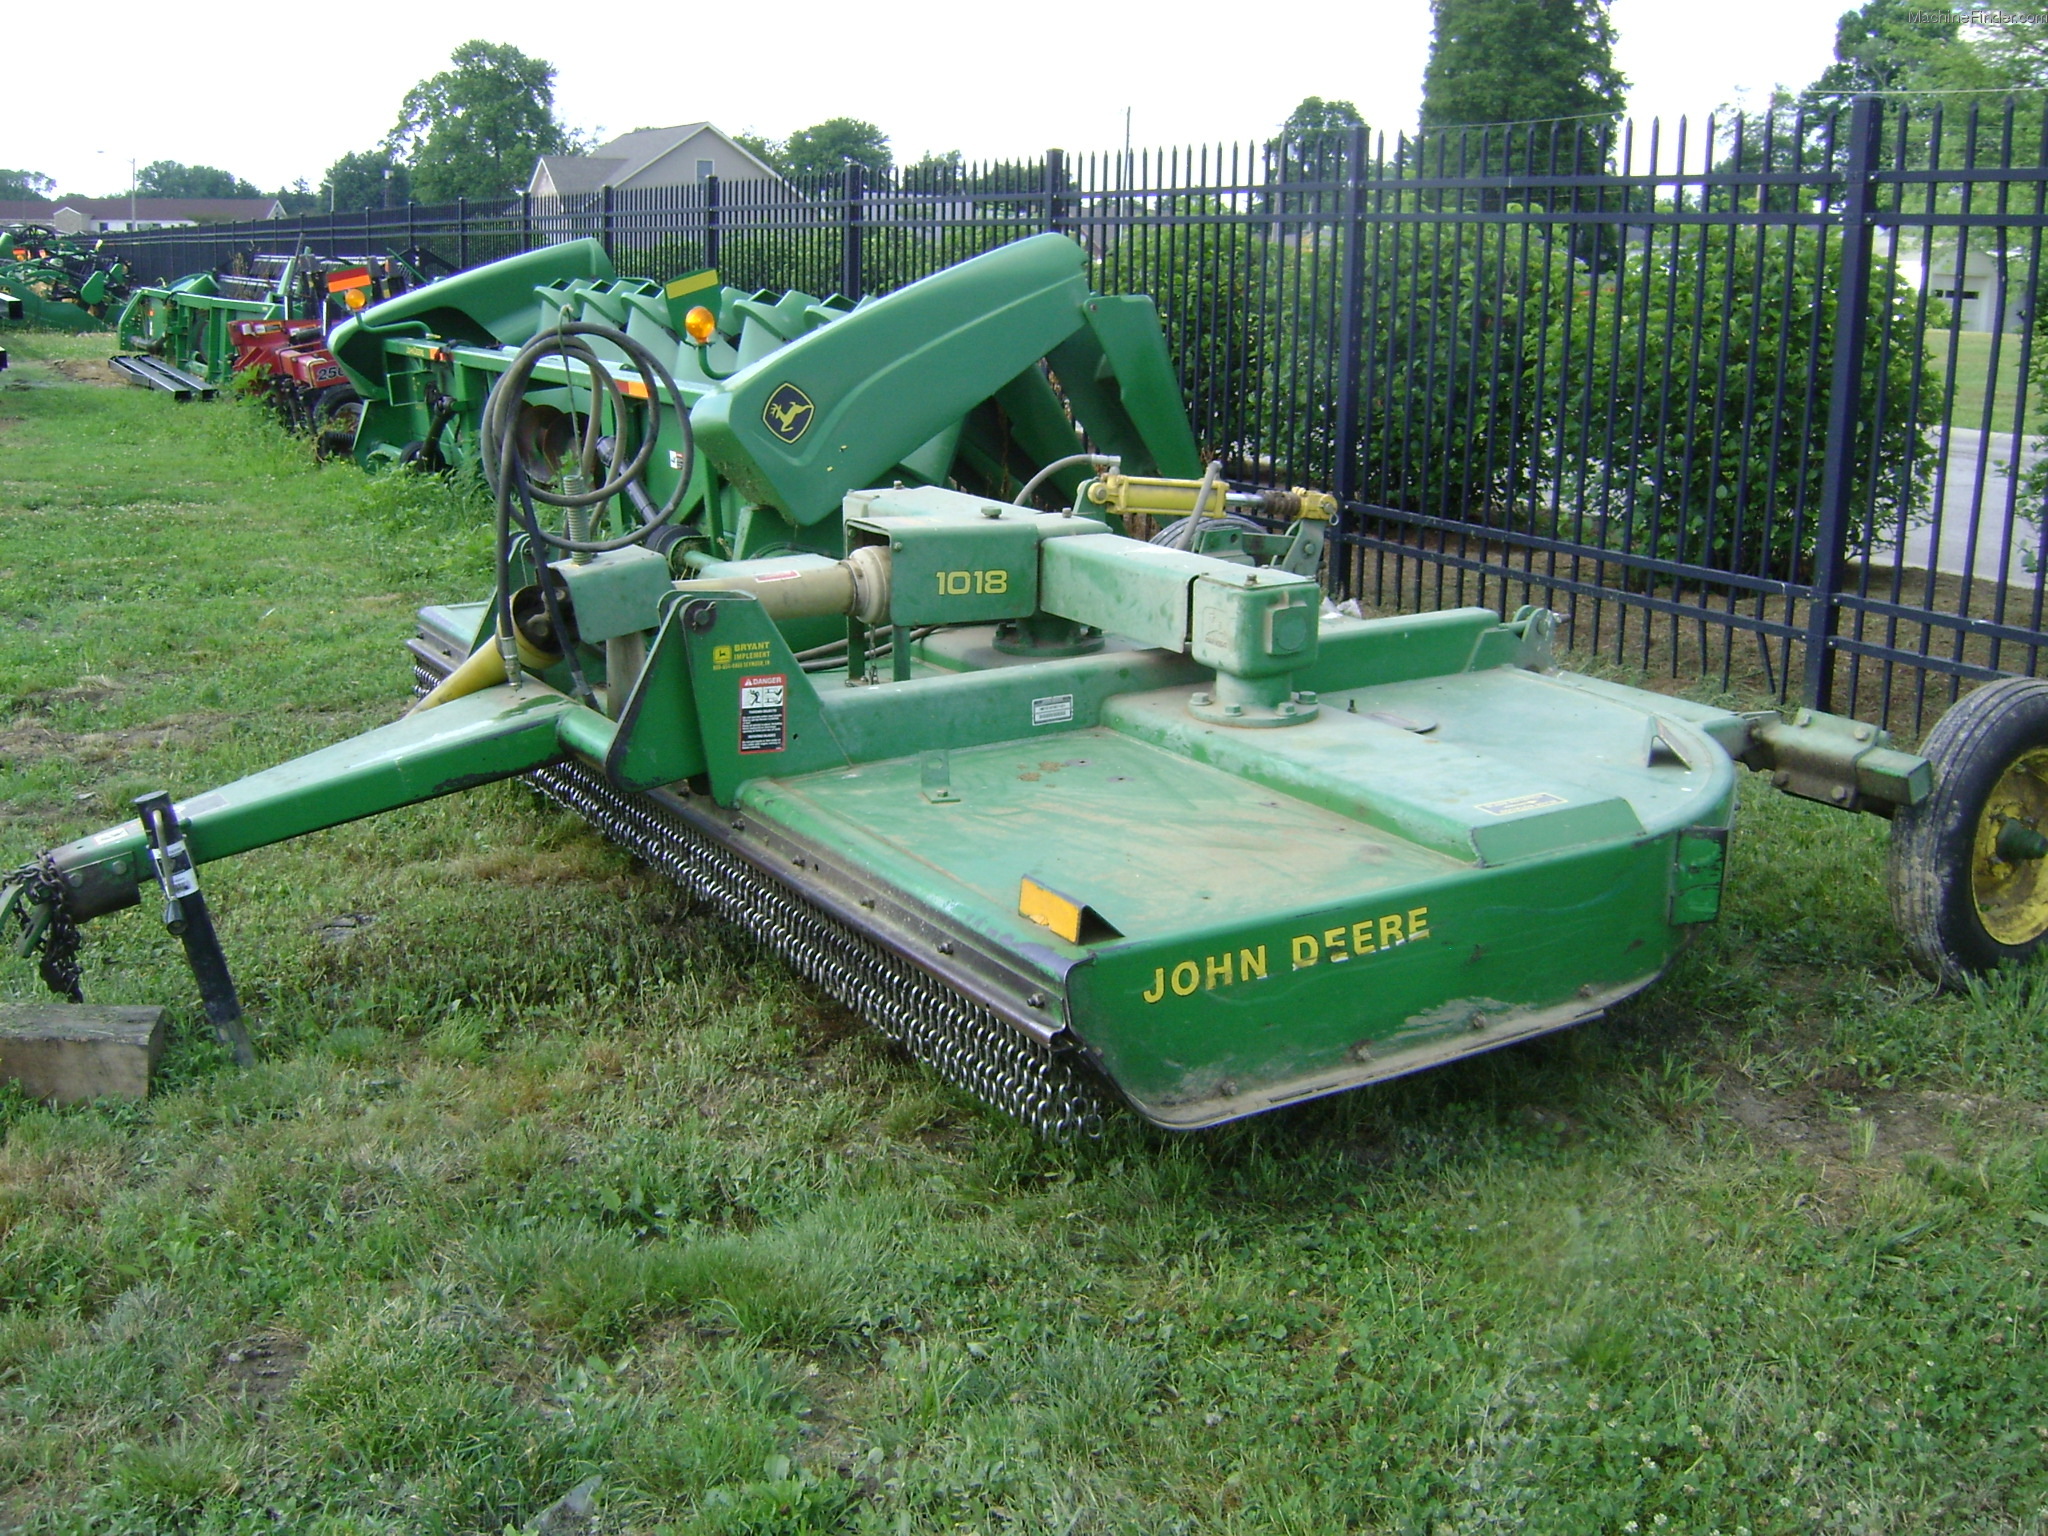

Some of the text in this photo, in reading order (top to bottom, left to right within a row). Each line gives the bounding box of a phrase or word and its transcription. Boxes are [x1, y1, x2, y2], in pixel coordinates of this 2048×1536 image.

[936, 570, 1007, 595] 1018
[734, 641, 770, 652] BRYANT
[734, 651, 770, 660] IMPLEMENT
[753, 677, 782, 685] DANGER
[1143, 906, 1430, 1004] JOHN DEERE
